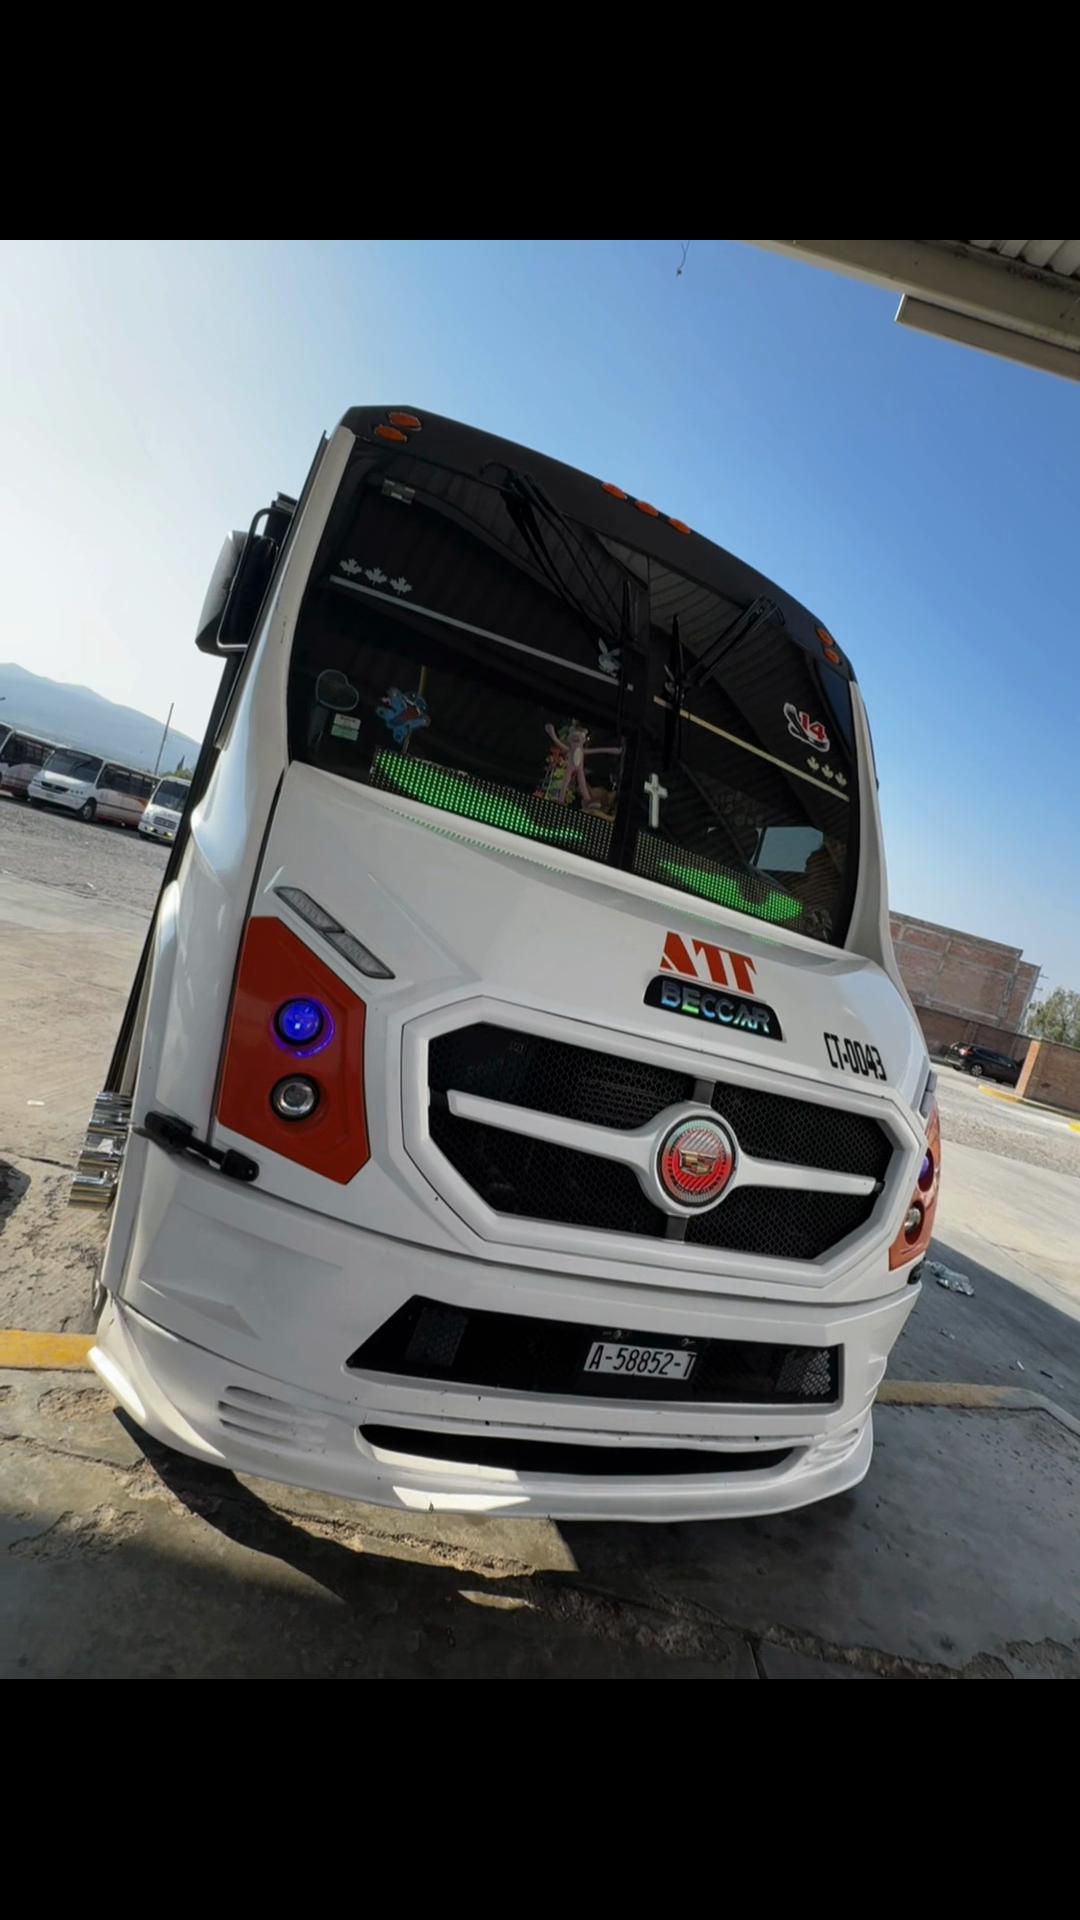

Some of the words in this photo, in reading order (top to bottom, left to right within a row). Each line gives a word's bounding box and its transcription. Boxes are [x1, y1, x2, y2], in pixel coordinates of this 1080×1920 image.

[800, 711, 828, 743] 14
[661, 981, 769, 1033] BECCAR
[823, 1032, 887, 1081] CT-0043
[588, 1344, 698, 1378] A-58852-T
